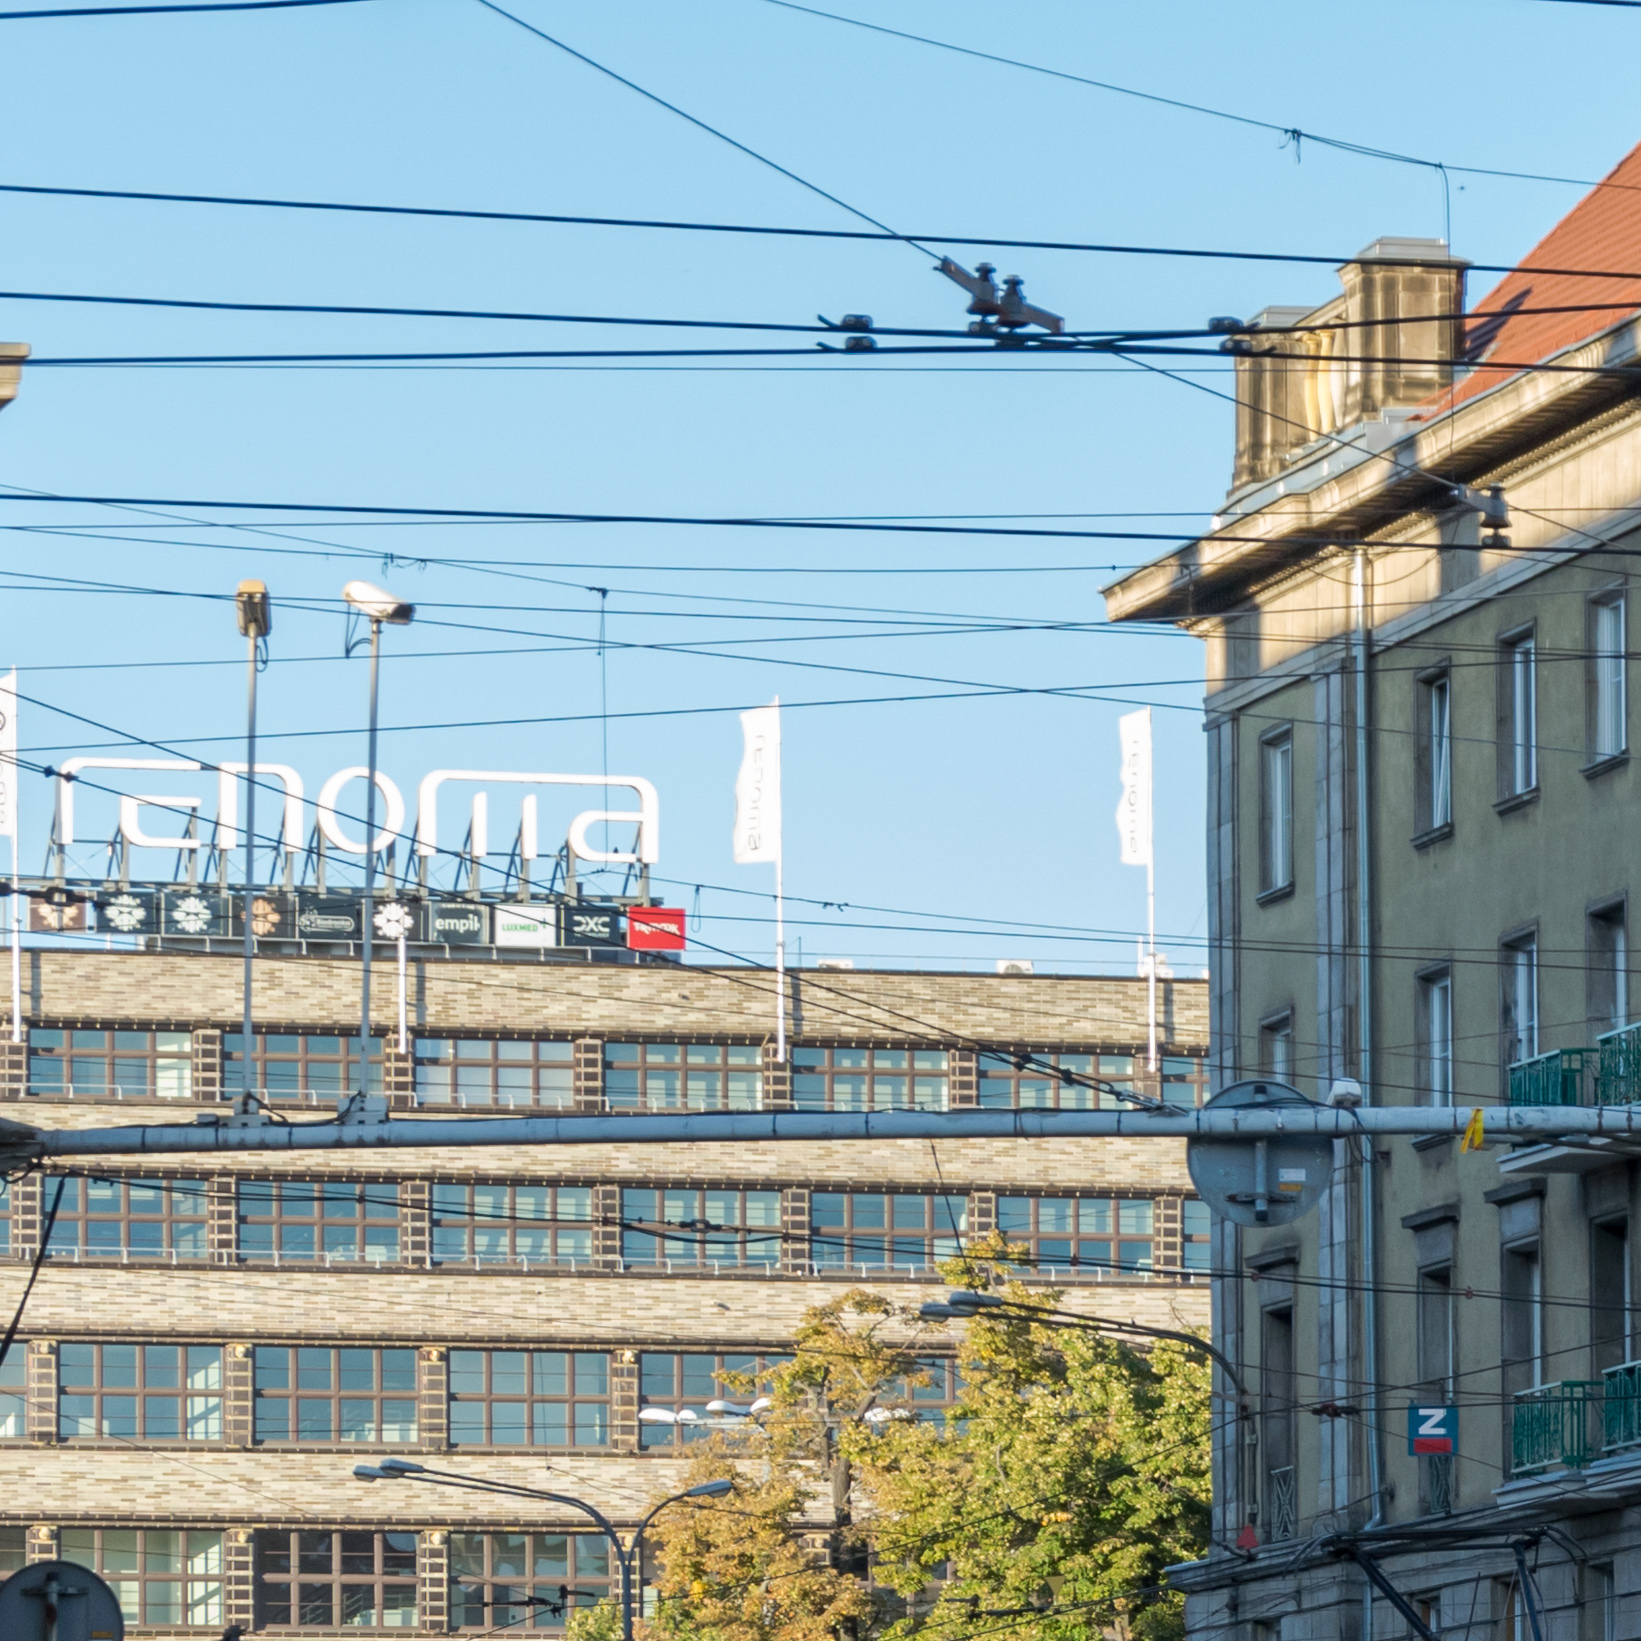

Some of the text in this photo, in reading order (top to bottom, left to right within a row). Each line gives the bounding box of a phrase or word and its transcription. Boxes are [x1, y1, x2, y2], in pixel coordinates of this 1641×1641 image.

[55, 757, 658, 864] renoma
[435, 914, 480, 934] empik
[1418, 1408, 1447, 1435] Z
